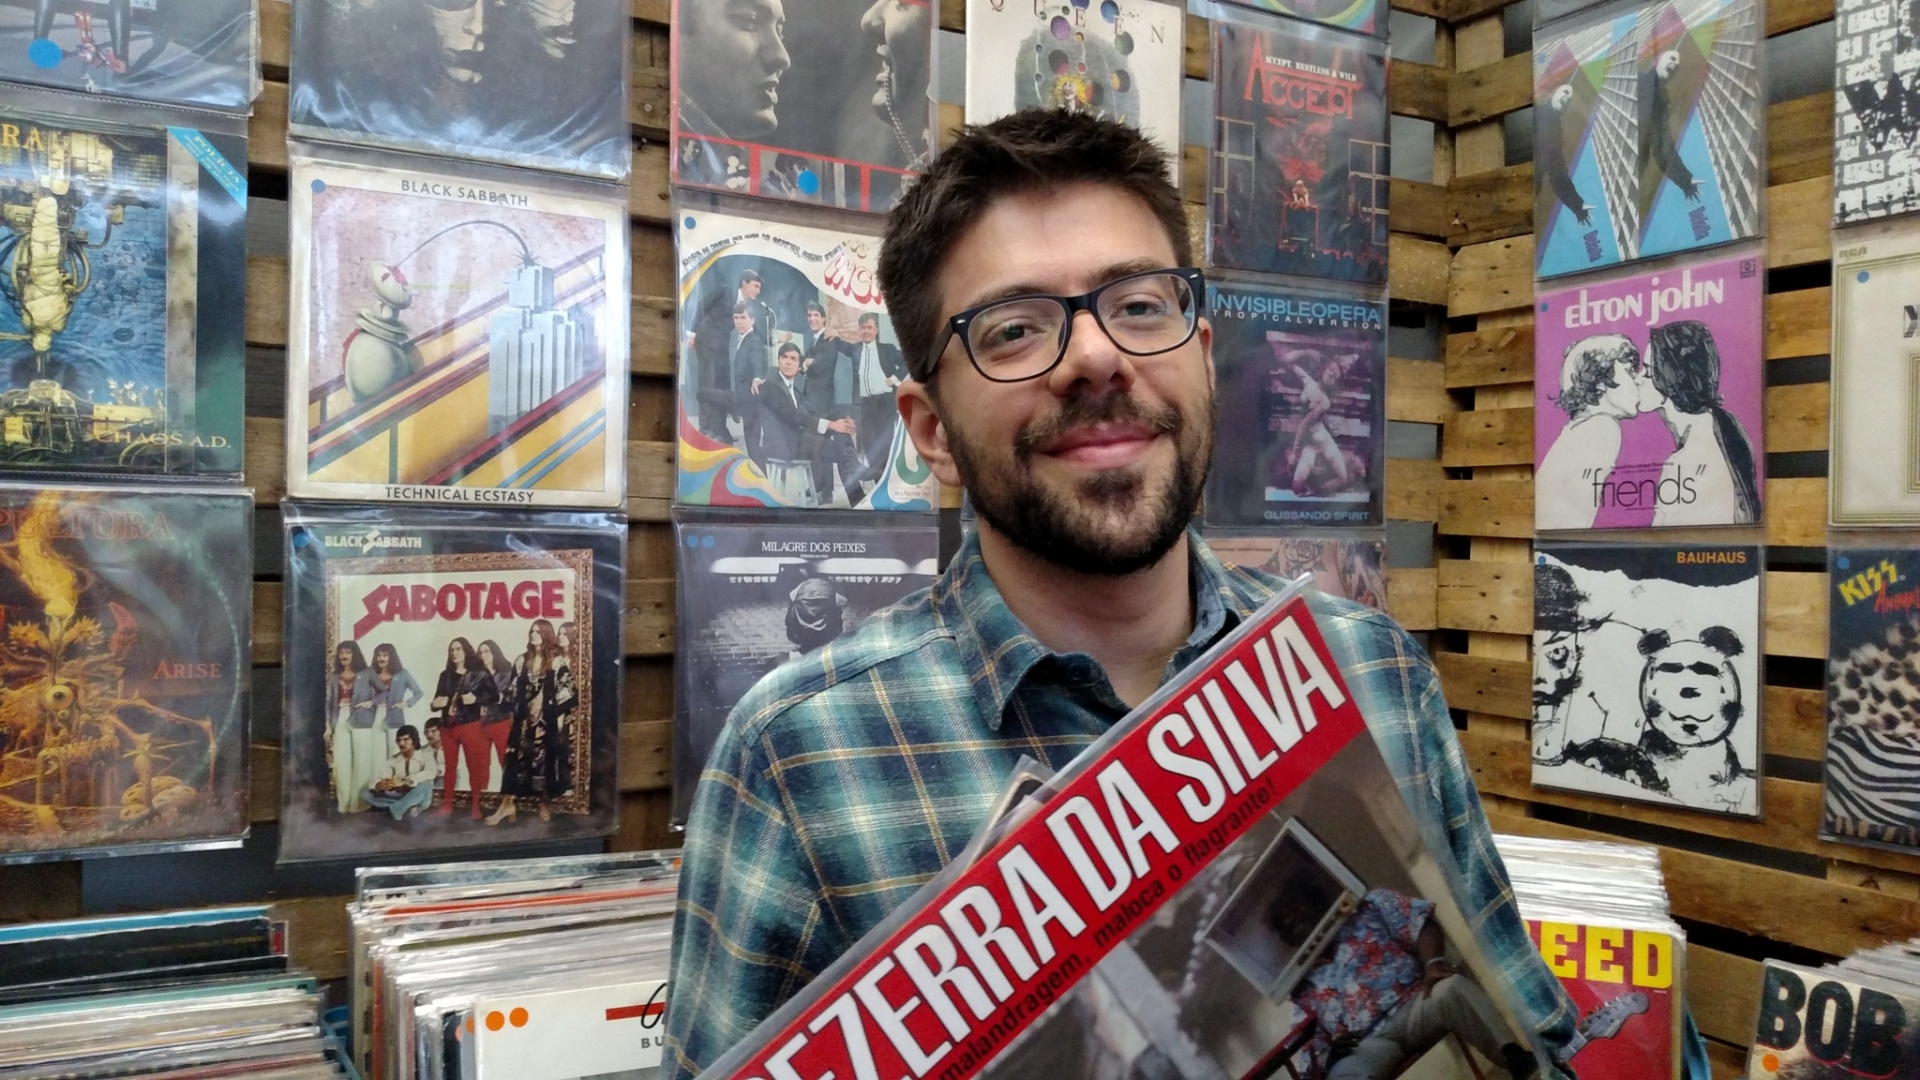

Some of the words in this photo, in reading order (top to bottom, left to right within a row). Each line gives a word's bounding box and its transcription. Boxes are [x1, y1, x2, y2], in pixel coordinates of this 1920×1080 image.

[1243, 32, 1364, 119] ACCEPT
[1295, 62, 1330, 76] RESTLESS
[1339, 71, 1357, 81] WILD
[401, 180, 452, 197] BLACK
[458, 187, 528, 207] SABBATH
[97, 431, 183, 445] CHAOS
[189, 435, 232, 449] A.D.
[385, 487, 469, 501] TECHNICAL
[474, 490, 535, 503] ECSTASY
[1263, 511, 1331, 521] GLISSANDO
[1333, 511, 1370, 520] SPIRIT
[324, 536, 363, 549] BLACK
[362, 528, 422, 554] SABBATH
[761, 541, 808, 552] MILAGRE
[809, 542, 831, 552] DOS
[832, 543, 866, 553] PEIXES
[1676, 551, 1747, 564] BAUHAUS
[1838, 558, 1898, 607] KISS
[353, 580, 565, 641] SABOTAGE
[153, 659, 222, 680] ARISE
[1044, 758, 1181, 912] DA
[1146, 615, 1346, 823] SILVA
[1093, 881, 1165, 947] maloca
[1167, 863, 1183, 882] o
[1183, 776, 1278, 867] flagrante!
[1525, 920, 1673, 989] EED
[1757, 964, 1907, 1079] BOB
